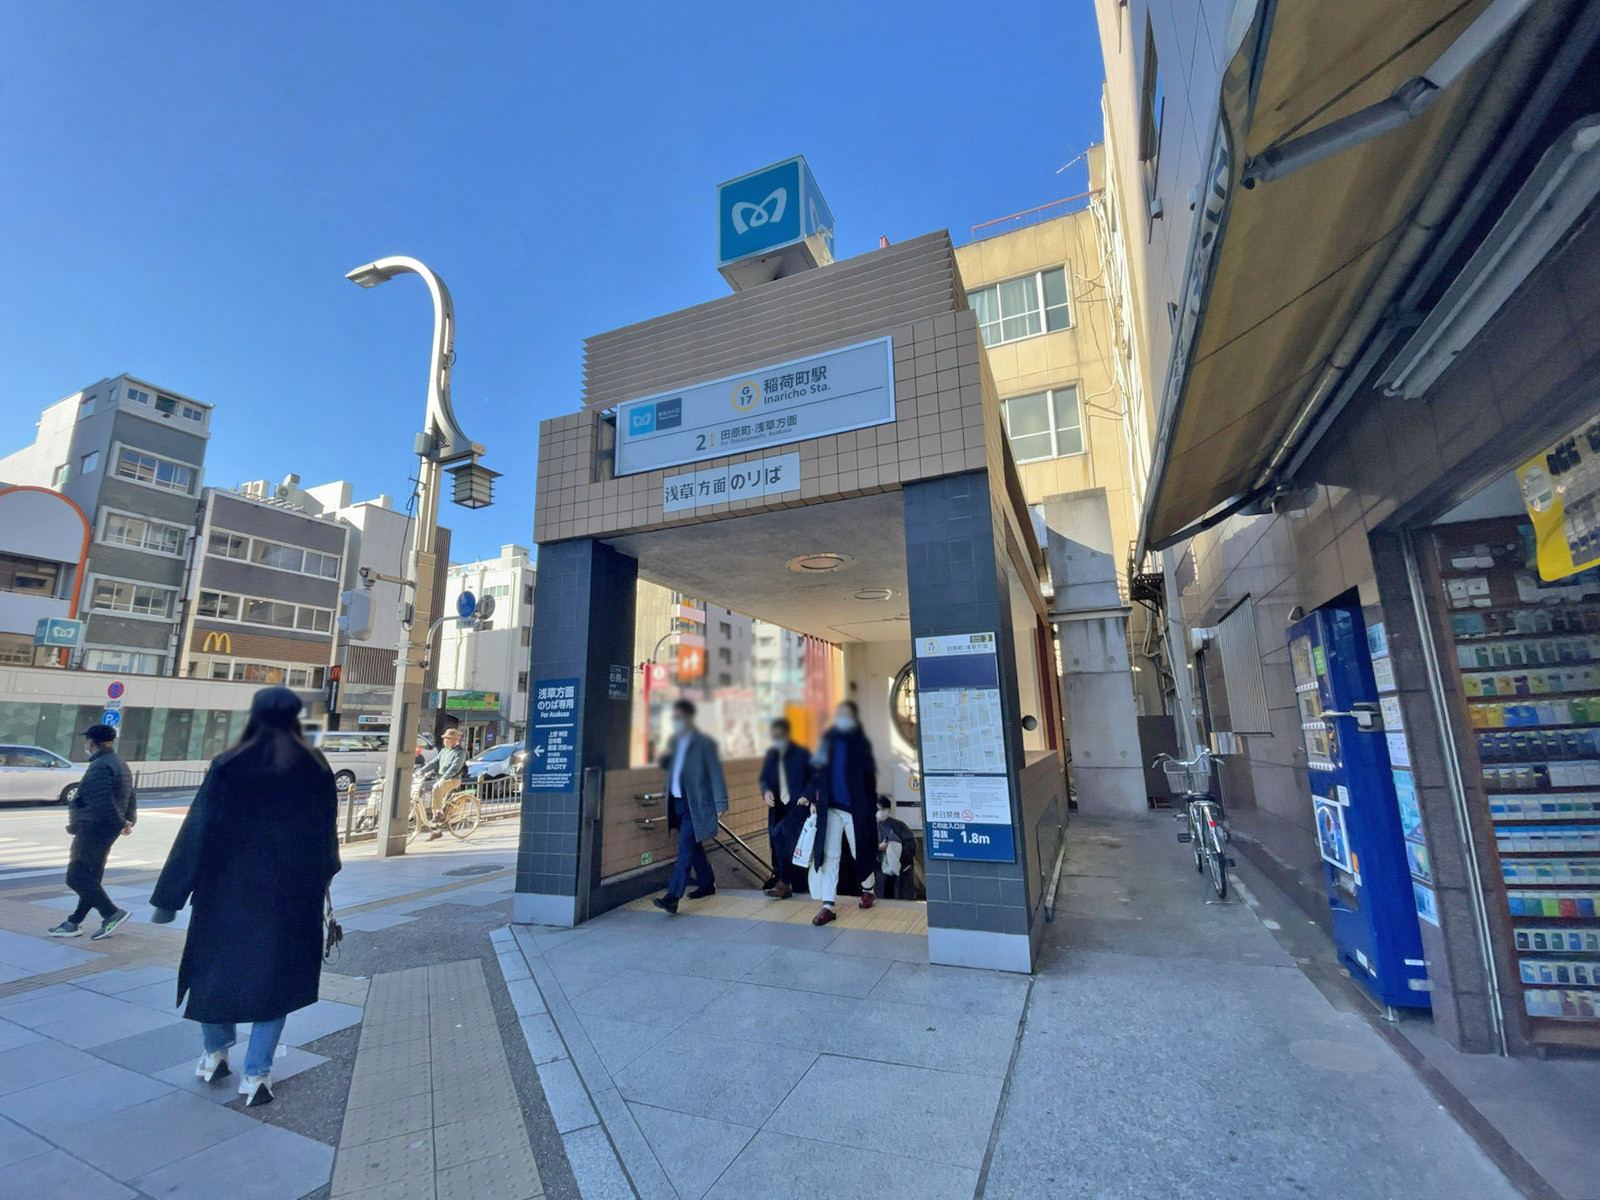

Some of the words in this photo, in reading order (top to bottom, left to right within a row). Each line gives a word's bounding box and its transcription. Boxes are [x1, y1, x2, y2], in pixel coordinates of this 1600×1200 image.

[763, 365, 827, 393] 稲荷町駅
[742, 386, 750, 395] G
[764, 388, 807, 405] Inaricho
[810, 382, 831, 395] Sta.
[740, 395, 753, 406] 17
[696, 434, 706, 451] 2
[664, 465, 783, 503] 浅草方面のりば
[538, 686, 575, 699] 浅草方面
[537, 699, 574, 710] のりば専用
[105, 714, 114, 725] P
[932, 822, 966, 830] この出入口は
[960, 830, 991, 844] 1.8m
